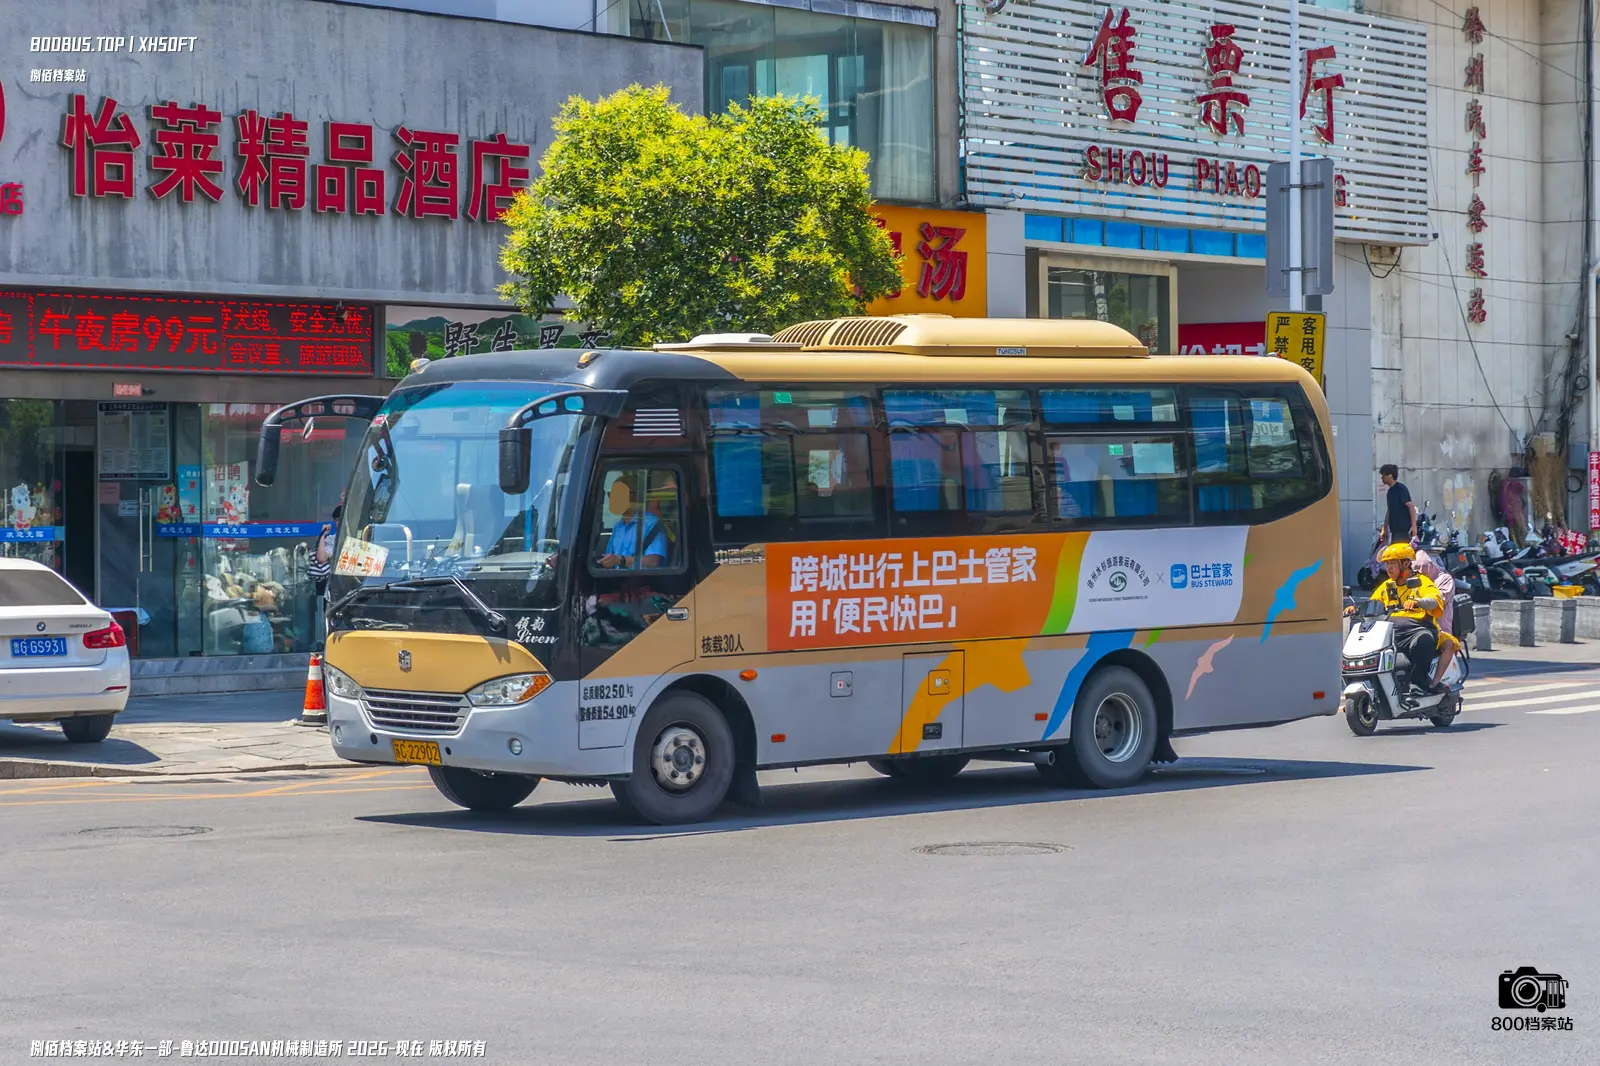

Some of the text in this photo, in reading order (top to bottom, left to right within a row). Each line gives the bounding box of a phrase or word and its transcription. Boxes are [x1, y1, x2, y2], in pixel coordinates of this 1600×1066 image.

[1082, 7, 1344, 145] 售票厅
[63, 94, 530, 223] 怡莱精品酒店
[1084, 145, 1261, 199] SHOU PIAO
[1462, 7, 1488, 324] 徐州汽车客运站
[39, 306, 217, 354] 午夜房99元
[1274, 316, 1290, 359] 严禁
[215, 464, 240, 481] 招聘
[5, 530, 44, 538] 欢迎光临
[265, 526, 300, 534] 欢迎光临
[789, 546, 1037, 592] 跨城出行上巴士管家
[1190, 563, 1233, 579] 巴士管家
[1190, 579, 1233, 588] BUS STEWARD
[513, 629, 560, 644] Liven
[789, 594, 957, 637] 用「便民快巴」
[701, 634, 744, 653] 核载30人
